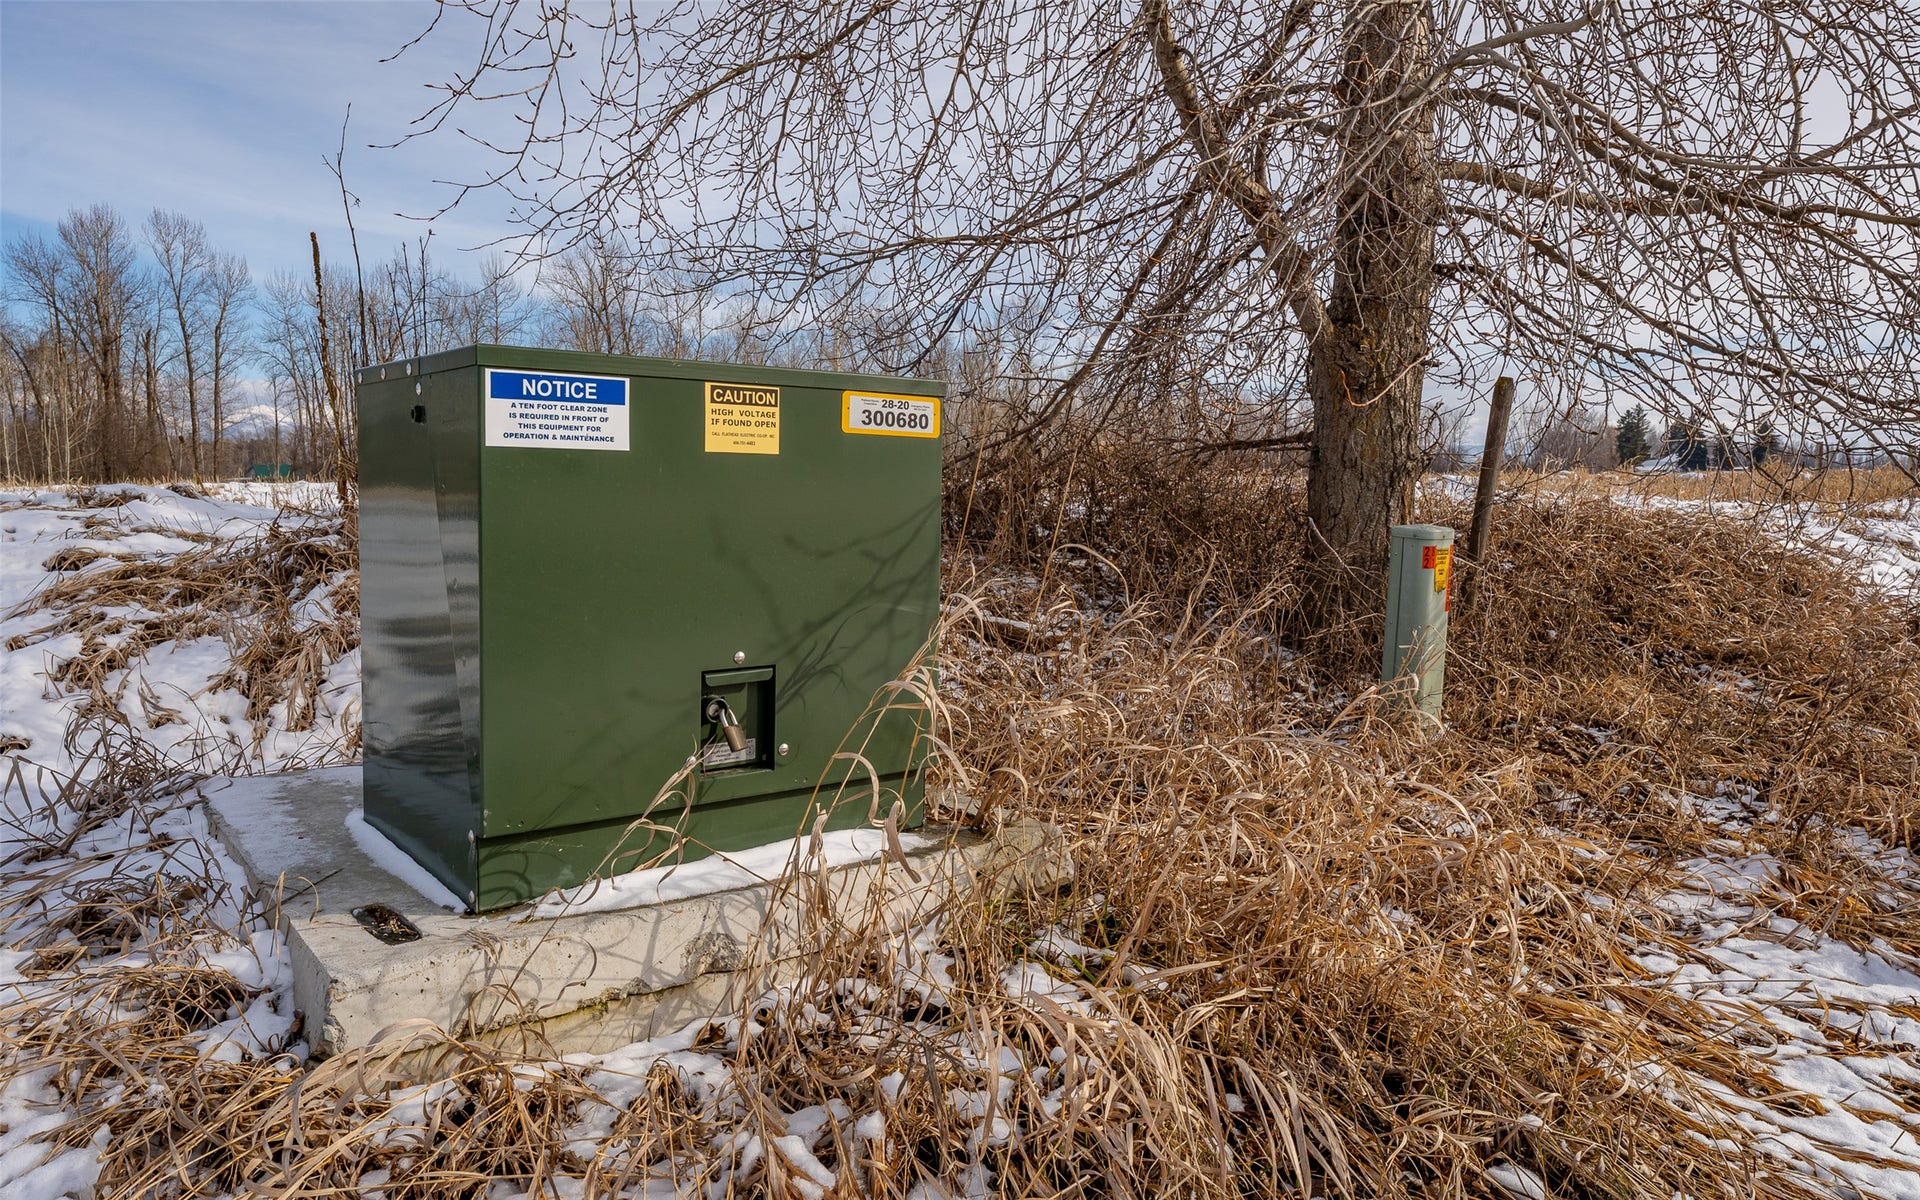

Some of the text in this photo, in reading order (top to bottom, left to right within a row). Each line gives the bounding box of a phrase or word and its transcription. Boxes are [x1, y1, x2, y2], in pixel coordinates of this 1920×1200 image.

[522, 378, 598, 400] NOTICE
[713, 388, 776, 406] CAUTION
[881, 399, 910, 410] 28-20
[739, 410, 776, 418] VOLTAGE
[722, 419, 752, 427] FOUND
[861, 410, 929, 430] 300680
[539, 424, 584, 432] EQUIPMENT
[560, 434, 615, 442] MAINTENANCE
